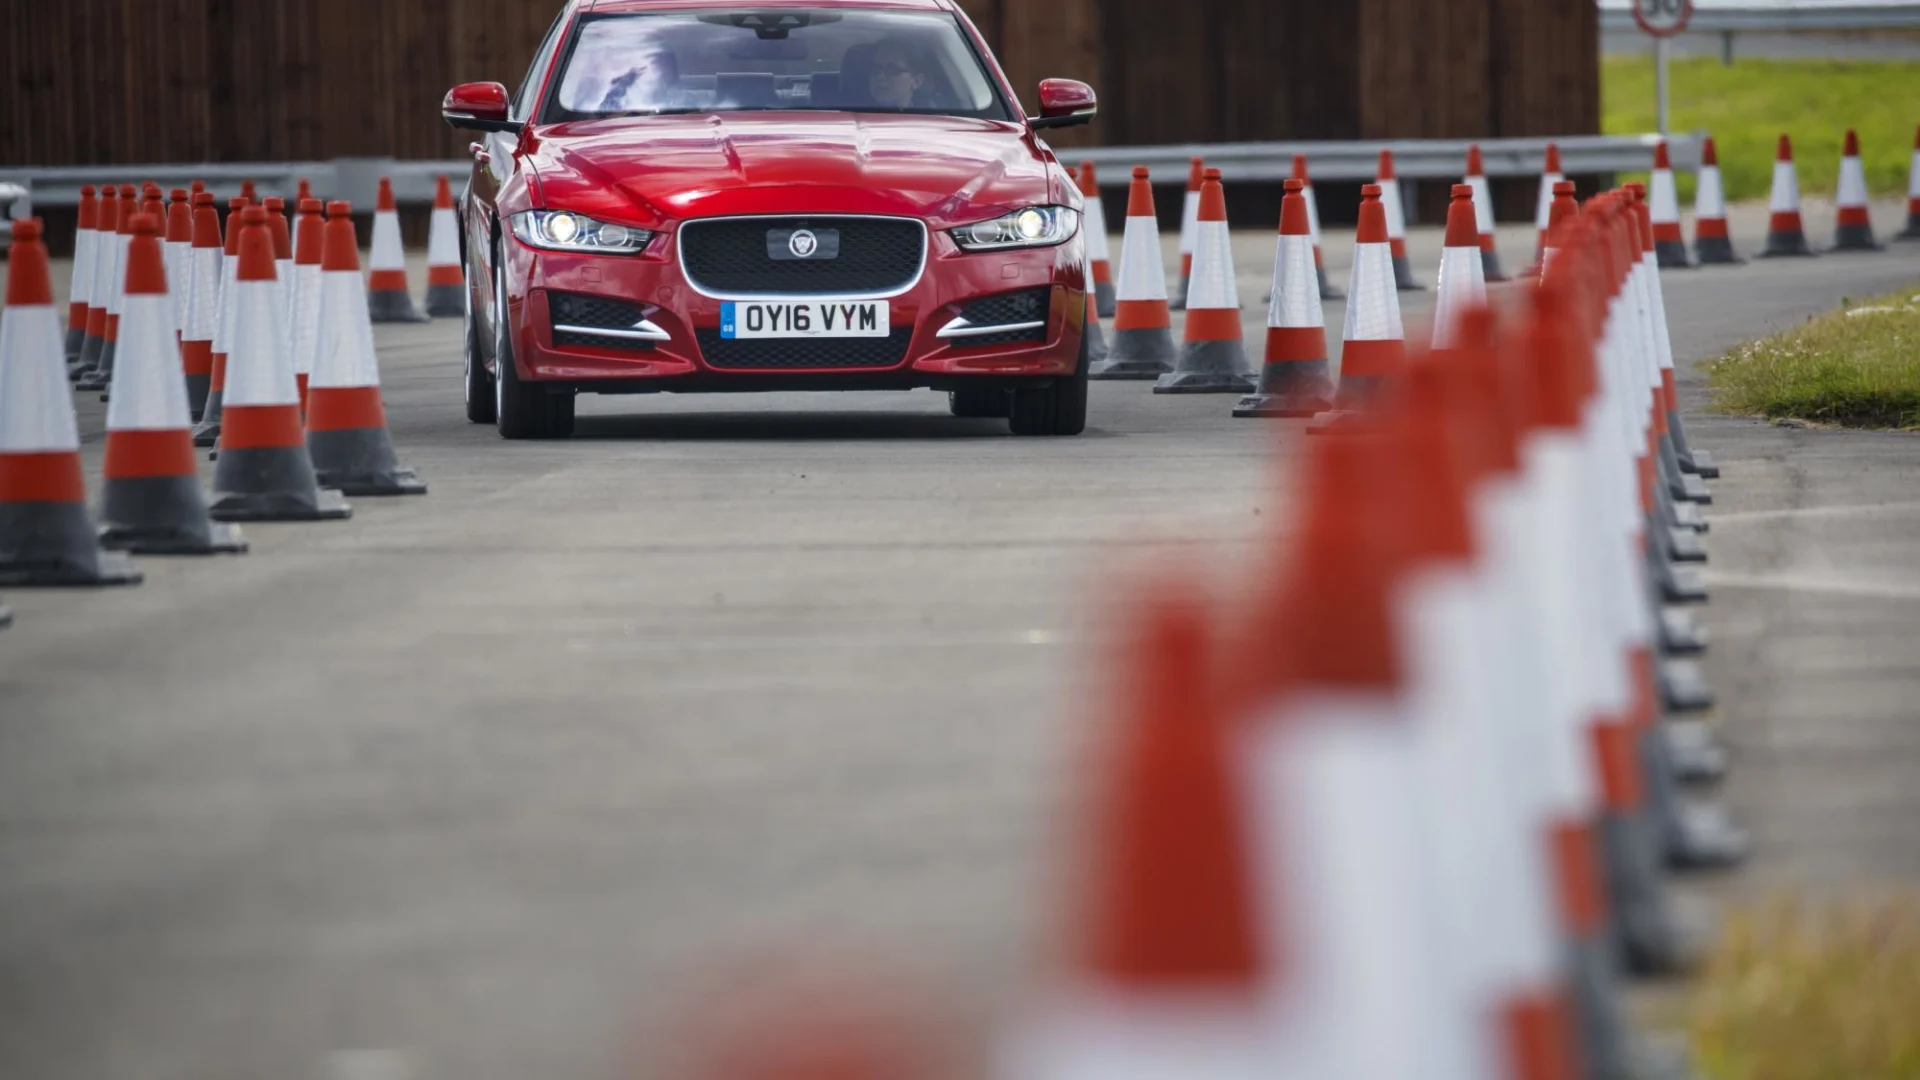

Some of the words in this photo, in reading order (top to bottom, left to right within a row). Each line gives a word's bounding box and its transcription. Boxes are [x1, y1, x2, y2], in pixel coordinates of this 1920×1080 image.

[747, 305, 810, 331] OY16
[820, 304, 876, 330] VYM
[722, 324, 734, 332] GB
